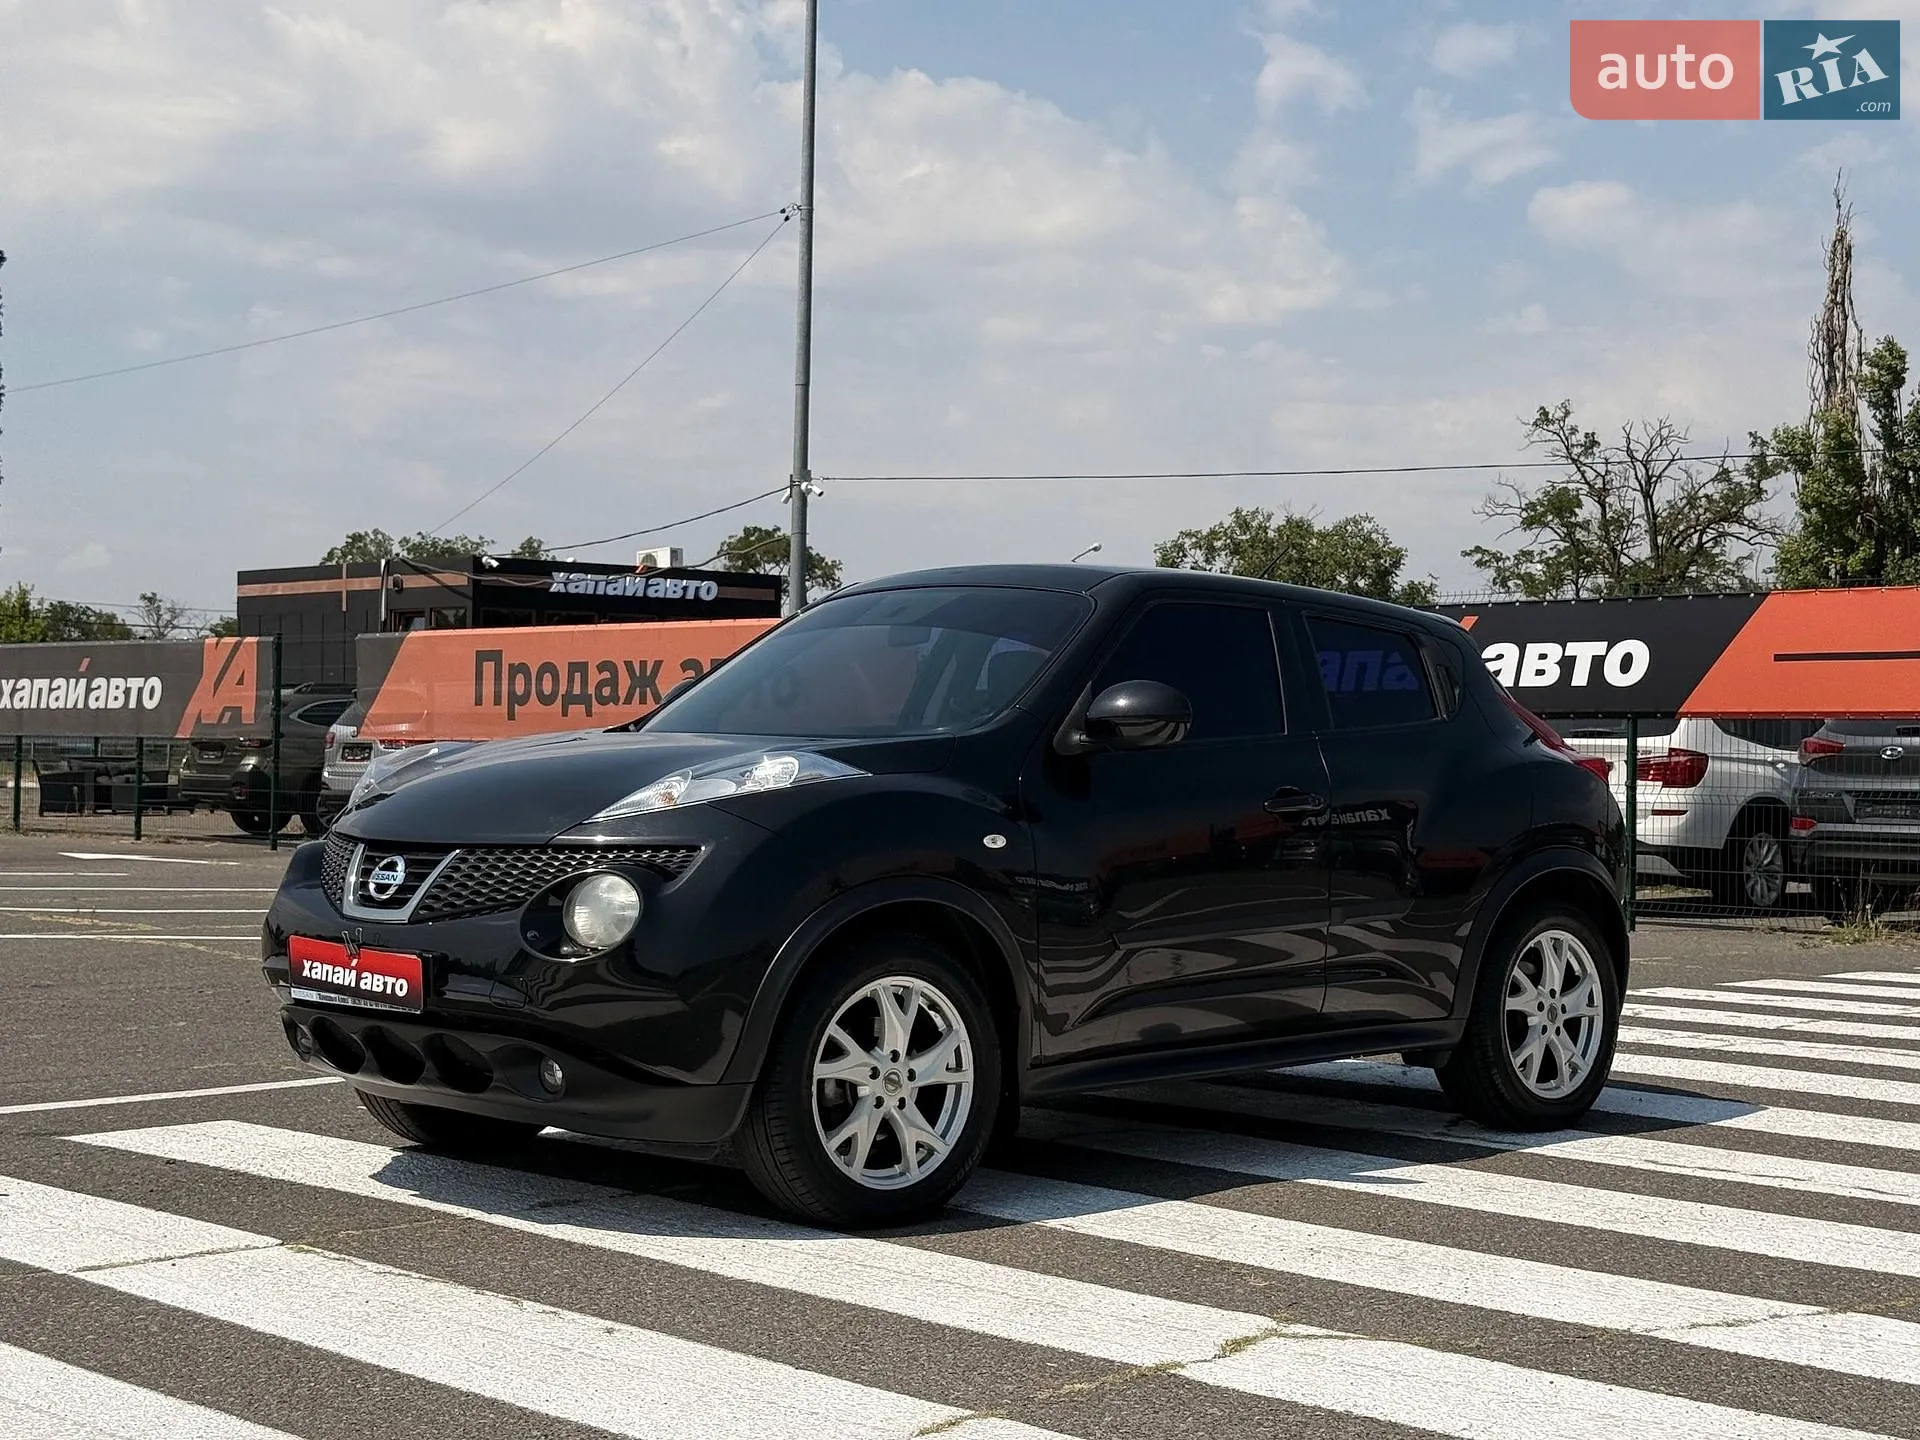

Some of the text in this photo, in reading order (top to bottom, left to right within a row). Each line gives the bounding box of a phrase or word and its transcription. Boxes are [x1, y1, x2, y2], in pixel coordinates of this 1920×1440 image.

[474, 649, 666, 720] Продаж
[1481, 638, 1650, 687] авто
[301, 958, 409, 998] хапай авто
